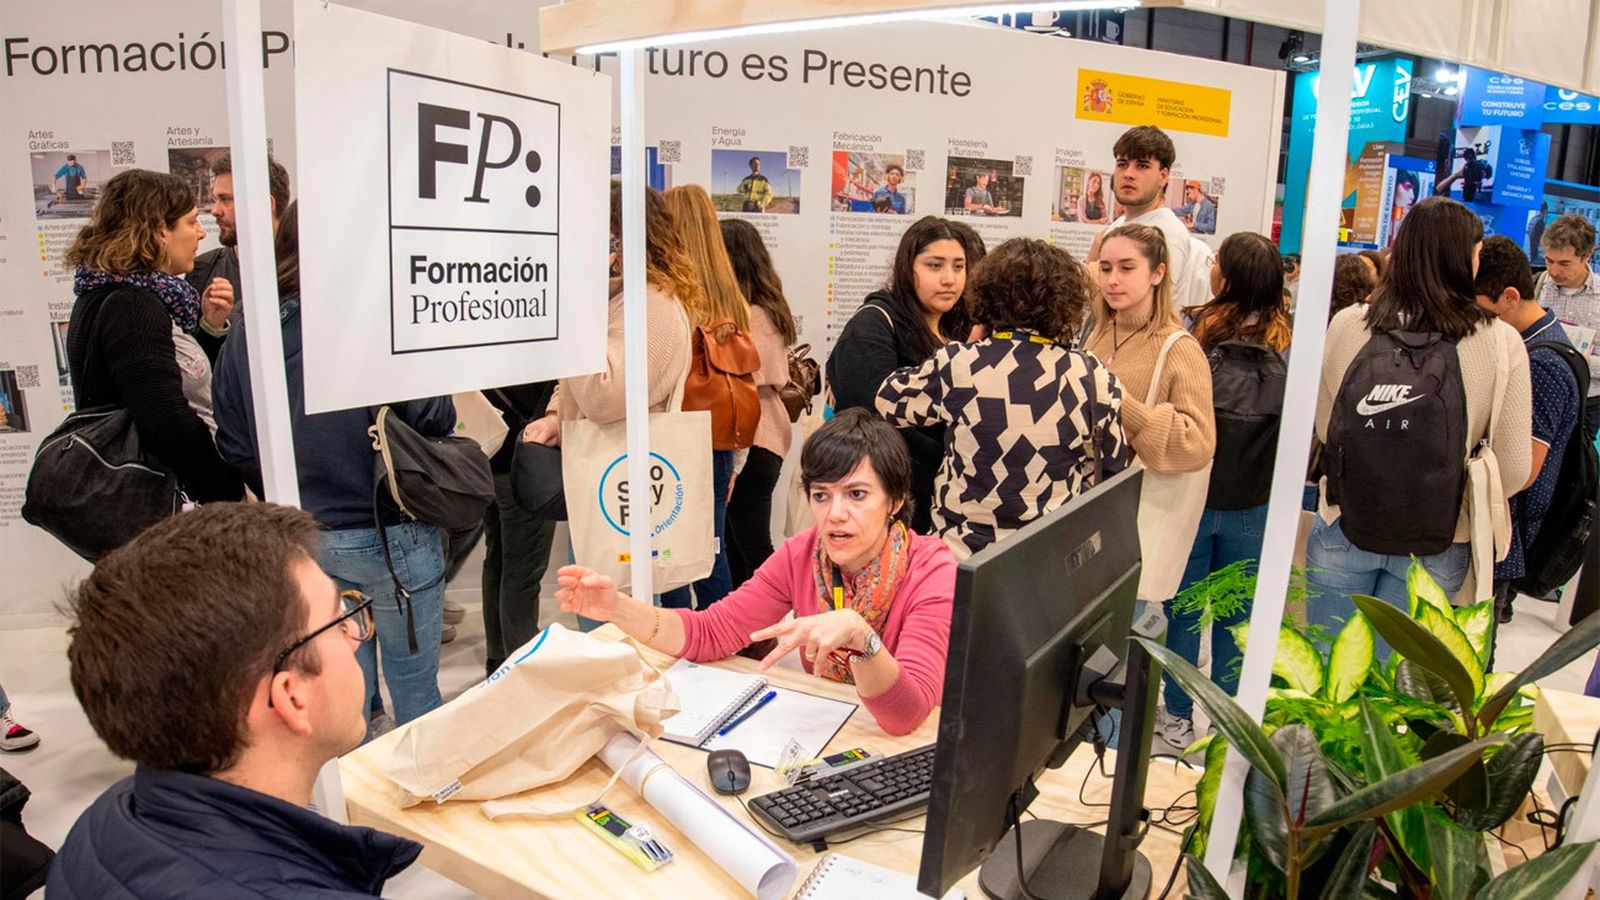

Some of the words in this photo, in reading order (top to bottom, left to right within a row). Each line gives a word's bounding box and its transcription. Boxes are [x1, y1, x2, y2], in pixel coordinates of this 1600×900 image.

[741, 53, 788, 82] es
[803, 49, 972, 97] Presente
[1117, 92, 1145, 100] GOBIERNO
[1392, 65, 1411, 122] CEV
[1125, 99, 1144, 107] ESPAÑA
[1157, 97, 1185, 106] MINISTERIO
[1481, 100, 1527, 110] CONSTRUYE
[1164, 104, 1195, 113] EDUCACIÓN
[1493, 109, 1524, 117] FUTURO
[1161, 110, 1191, 120] FORMACIÓN
[1191, 114, 1222, 124] PROFESIONAL
[28, 130, 54, 140] Artes
[166, 126, 192, 136] Artes
[194, 128, 200, 138] y
[712, 127, 746, 138] Energía
[833, 131, 882, 143] Fabricación
[29, 140, 69, 150] Gráficas
[167, 135, 213, 146] Artesanía
[719, 136, 742, 146] Agua
[833, 140, 874, 152] Mecánica
[948, 137, 988, 148] Hostelería
[954, 148, 985, 157] Turismo
[1056, 147, 1083, 158] Imagen
[1055, 155, 1085, 165] Personal
[410, 255, 548, 285] Formación
[411, 288, 547, 324] Profesional
[1367, 384, 1413, 402] NIKE
[1365, 419, 1409, 430] AIR
[617, 481, 665, 505] Sy
[655, 484, 684, 534] Orientación
